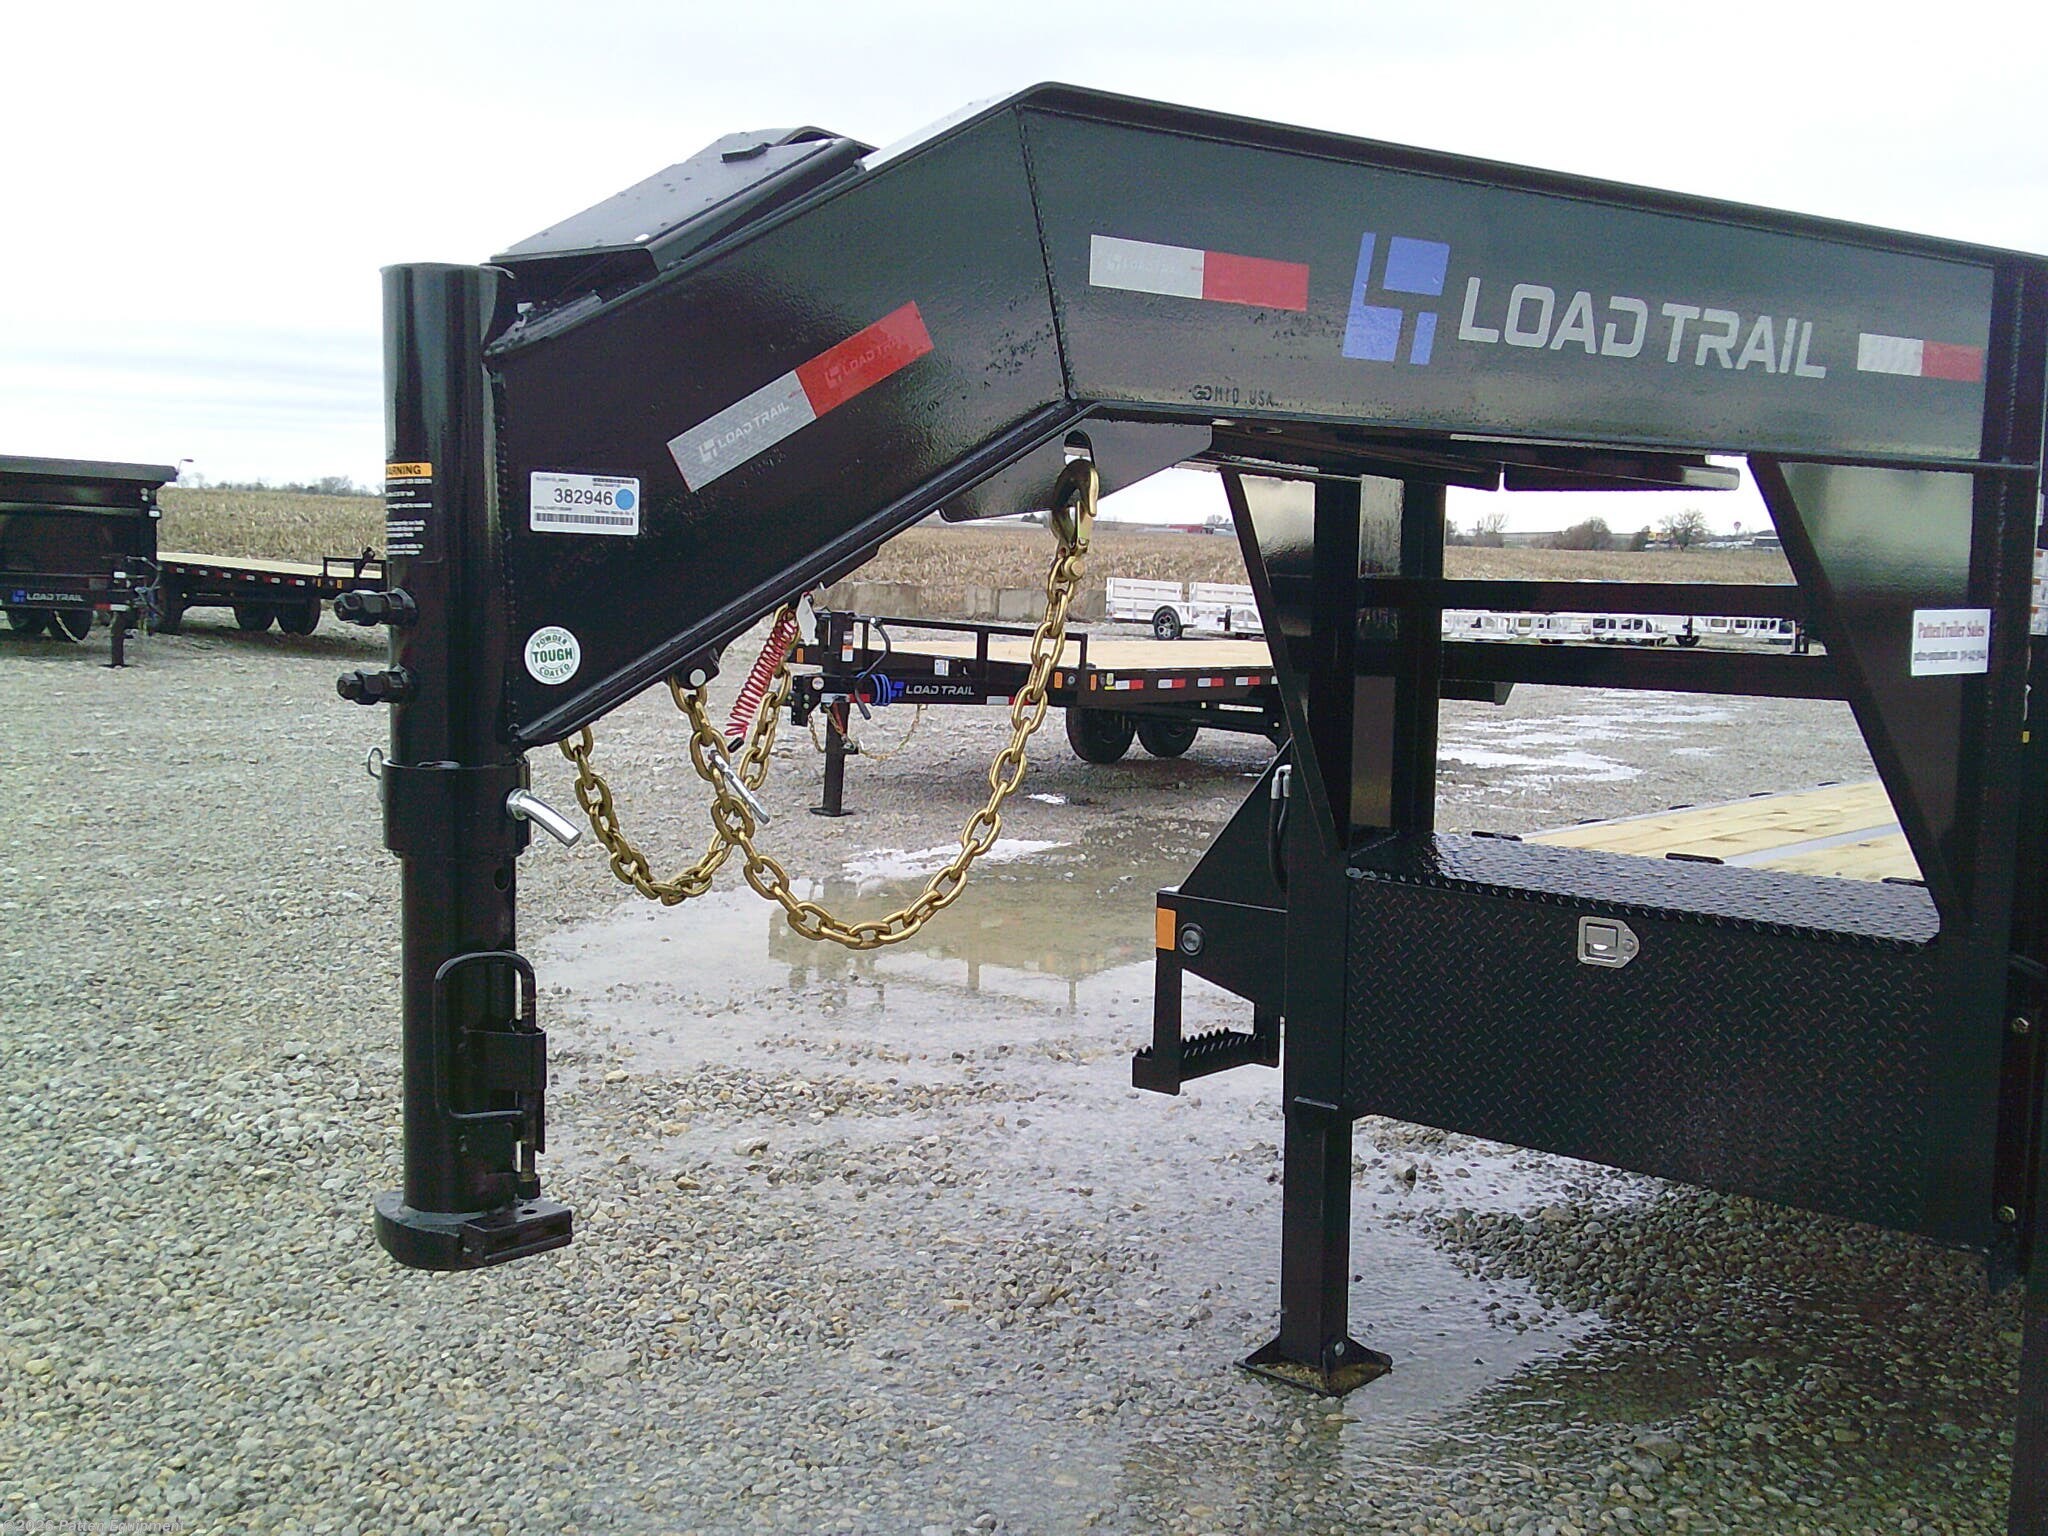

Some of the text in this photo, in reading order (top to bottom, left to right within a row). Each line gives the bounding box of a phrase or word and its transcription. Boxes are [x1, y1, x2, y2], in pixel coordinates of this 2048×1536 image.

[553, 487, 614, 506] 382946
[535, 634, 568, 649] POWDER
[531, 647, 573, 664] TOUGH
[539, 663, 570, 677] COATED
